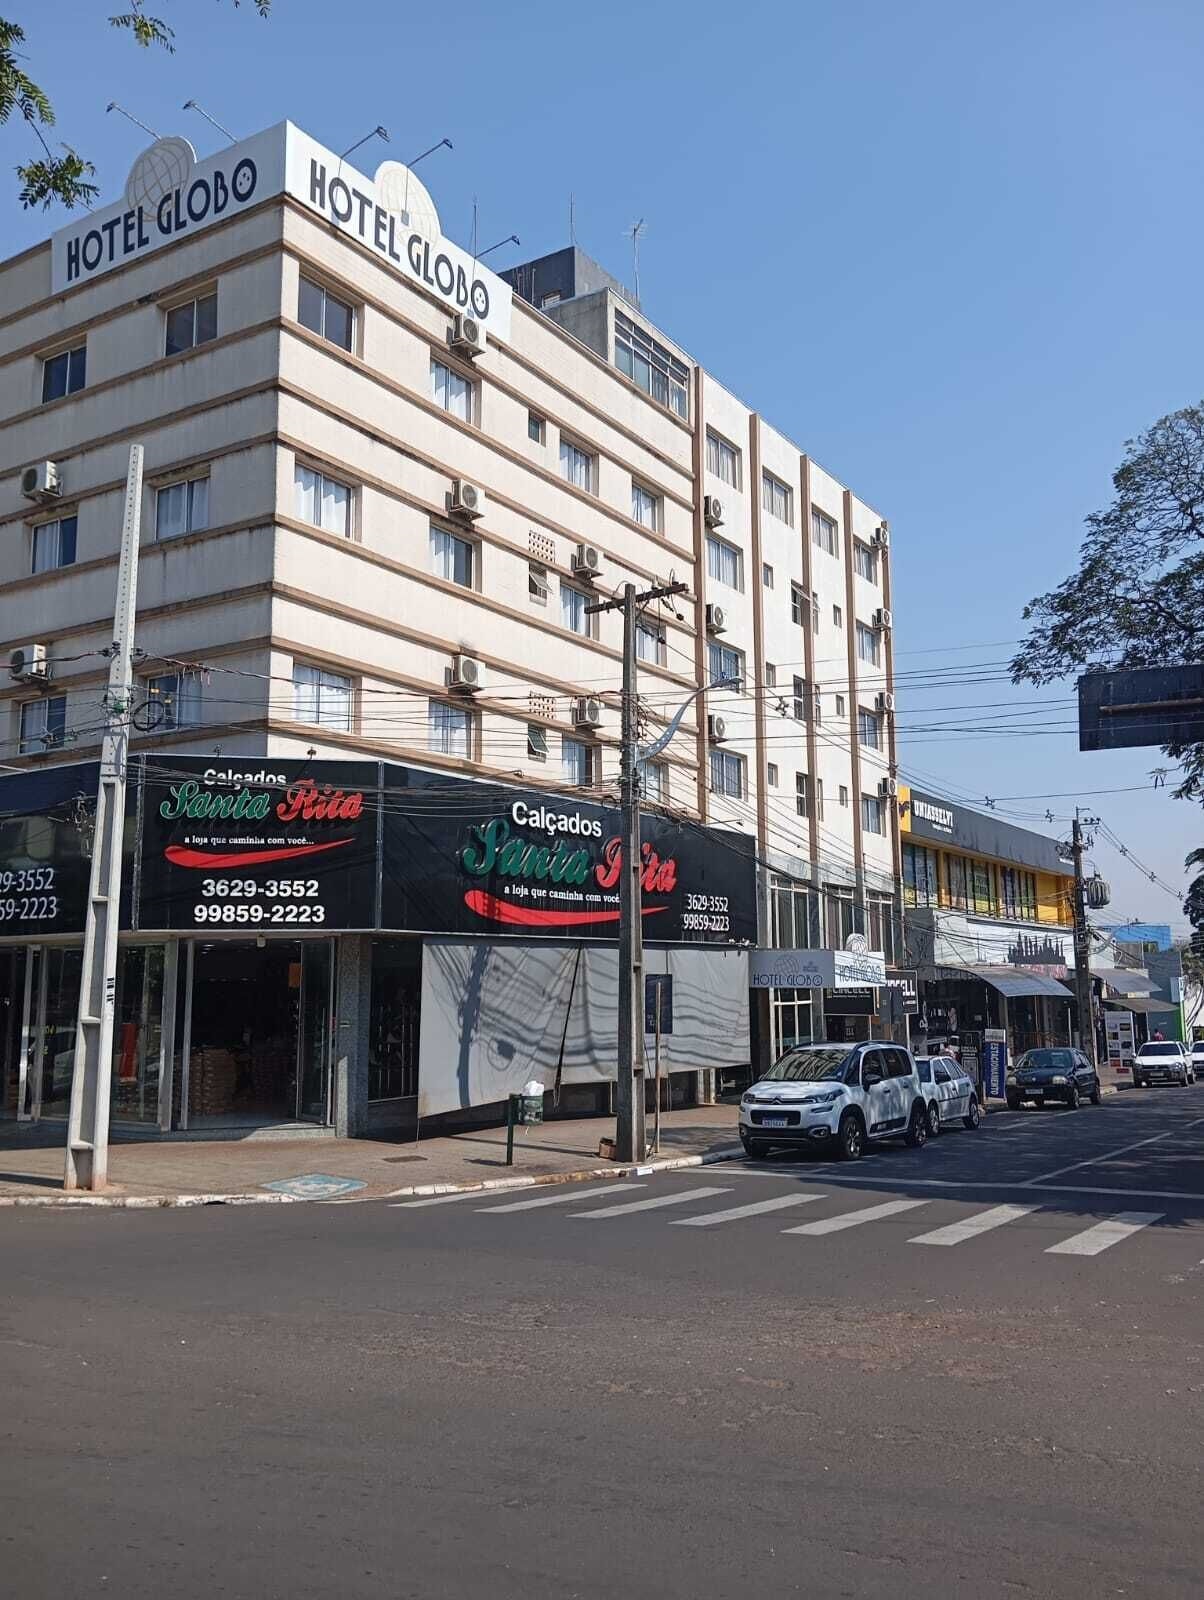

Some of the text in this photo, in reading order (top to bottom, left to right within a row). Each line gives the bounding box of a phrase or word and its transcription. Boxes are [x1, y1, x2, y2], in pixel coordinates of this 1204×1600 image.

[67, 157, 257, 282] HOTEL GLOBO
[310, 158, 489, 320] HOTEL GLOBO
[203, 769, 287, 790] Calçados
[160, 778, 364, 821] Santa Rita
[512, 801, 602, 838] Calçados
[184, 836, 190, 844] a
[192, 835, 208, 846] loja
[210, 837, 226, 846] que
[228, 835, 265, 844] caminha
[463, 817, 589, 884] Santa
[202, 879, 319, 898] 3629-3552
[503, 885, 510, 894] a
[512, 884, 529, 897] loja
[531, 888, 547, 899] que
[549, 889, 583, 901] caminha
[585, 893, 602, 902] com
[687, 894, 729, 912] 3629-3552
[194, 904, 326, 924] 99859-2223
[683, 913, 730, 931] 99859-2223
[753, 974, 823, 987] HOTEL GLOBO
